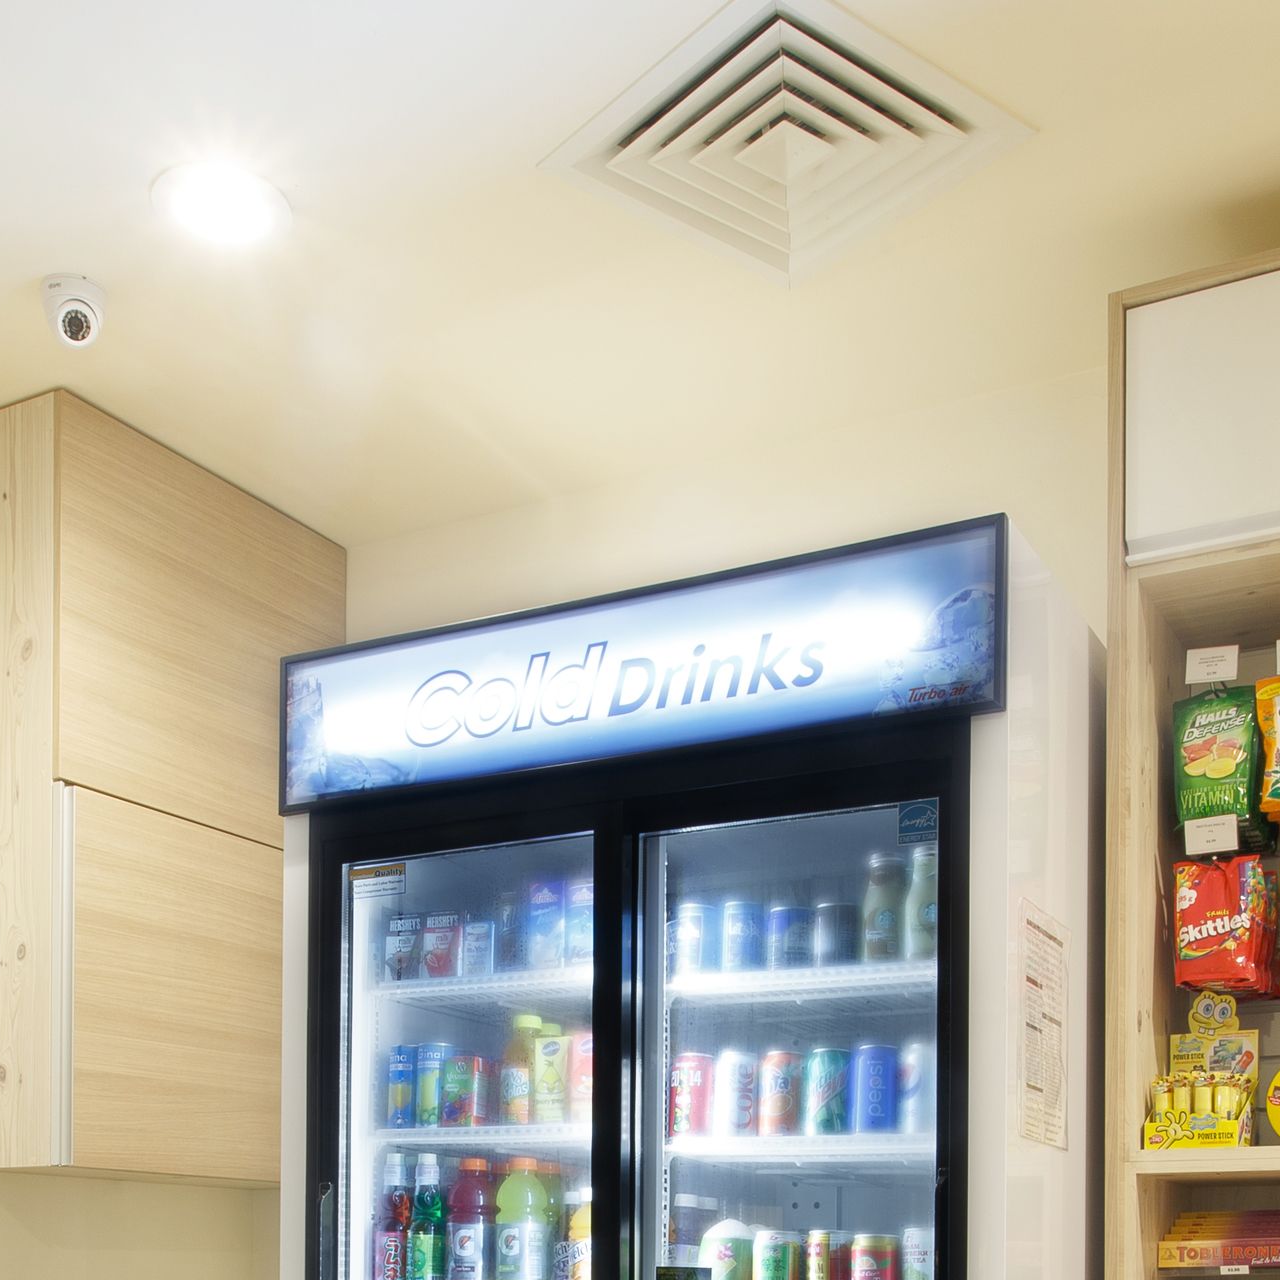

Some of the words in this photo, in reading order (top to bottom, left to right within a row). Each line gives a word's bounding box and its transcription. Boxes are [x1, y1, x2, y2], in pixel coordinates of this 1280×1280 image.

[403, 640, 609, 750] Cold
[608, 633, 826, 718] Drinks
[907, 685, 946, 705] Turbo
[949, 681, 971, 698] air
[1182, 714, 1248, 743] DEFENSE
[1194, 708, 1238, 727] HALLS
[375, 868, 403, 878] Quality
[389, 917, 421, 932] HERSHEY'S
[426, 914, 459, 929] HERSHEY'S
[1178, 912, 1251, 947] Skittles
[867, 1059, 886, 1117] pepsi
